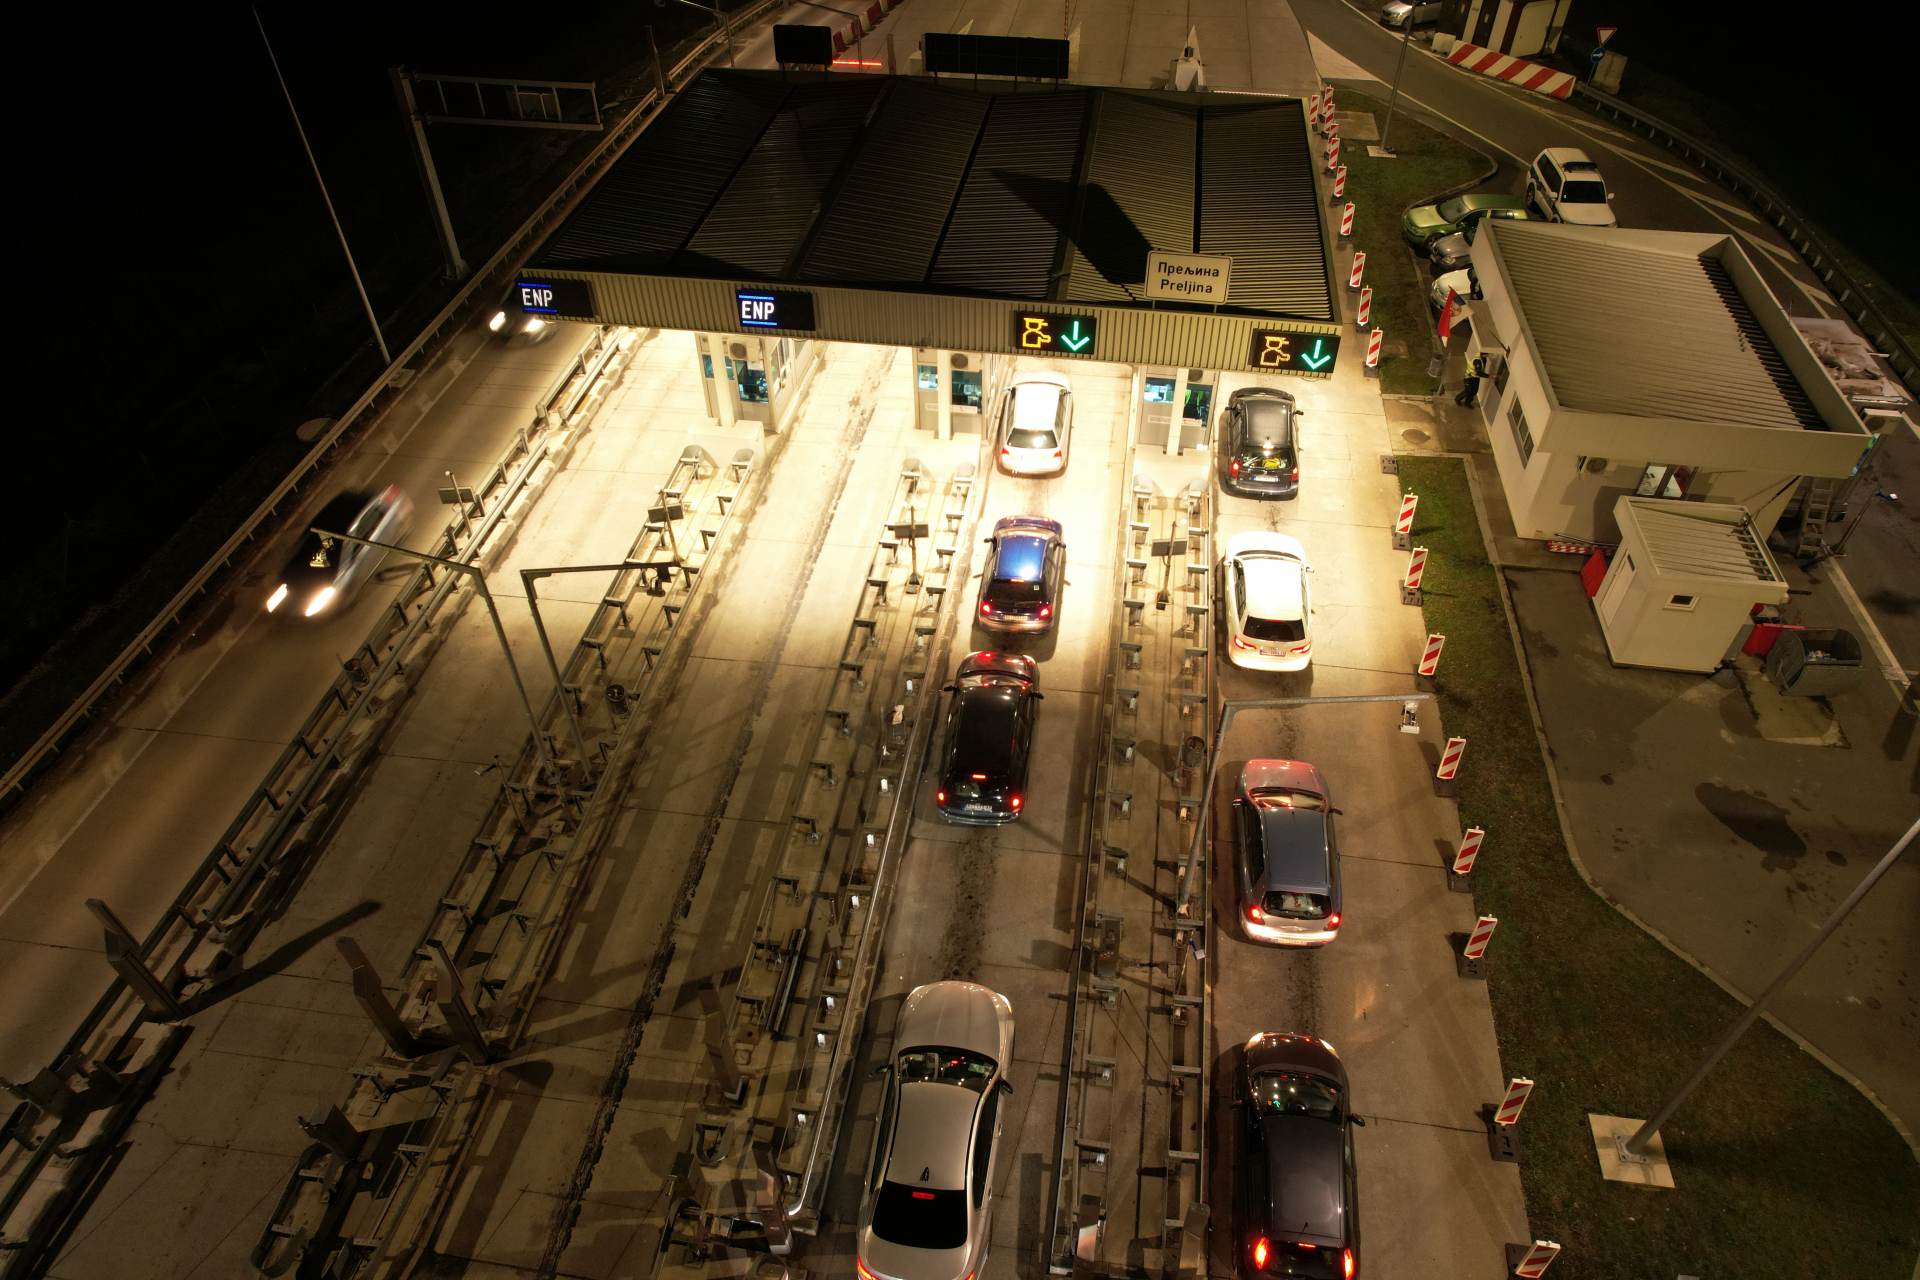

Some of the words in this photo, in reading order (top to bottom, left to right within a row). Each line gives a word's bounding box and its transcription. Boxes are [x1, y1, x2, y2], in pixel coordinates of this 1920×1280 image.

[1158, 261, 1219, 277] Прељина
[1160, 278, 1212, 294] Preljina
[522, 288, 553, 307] ENP
[742, 300, 775, 320] ENP
